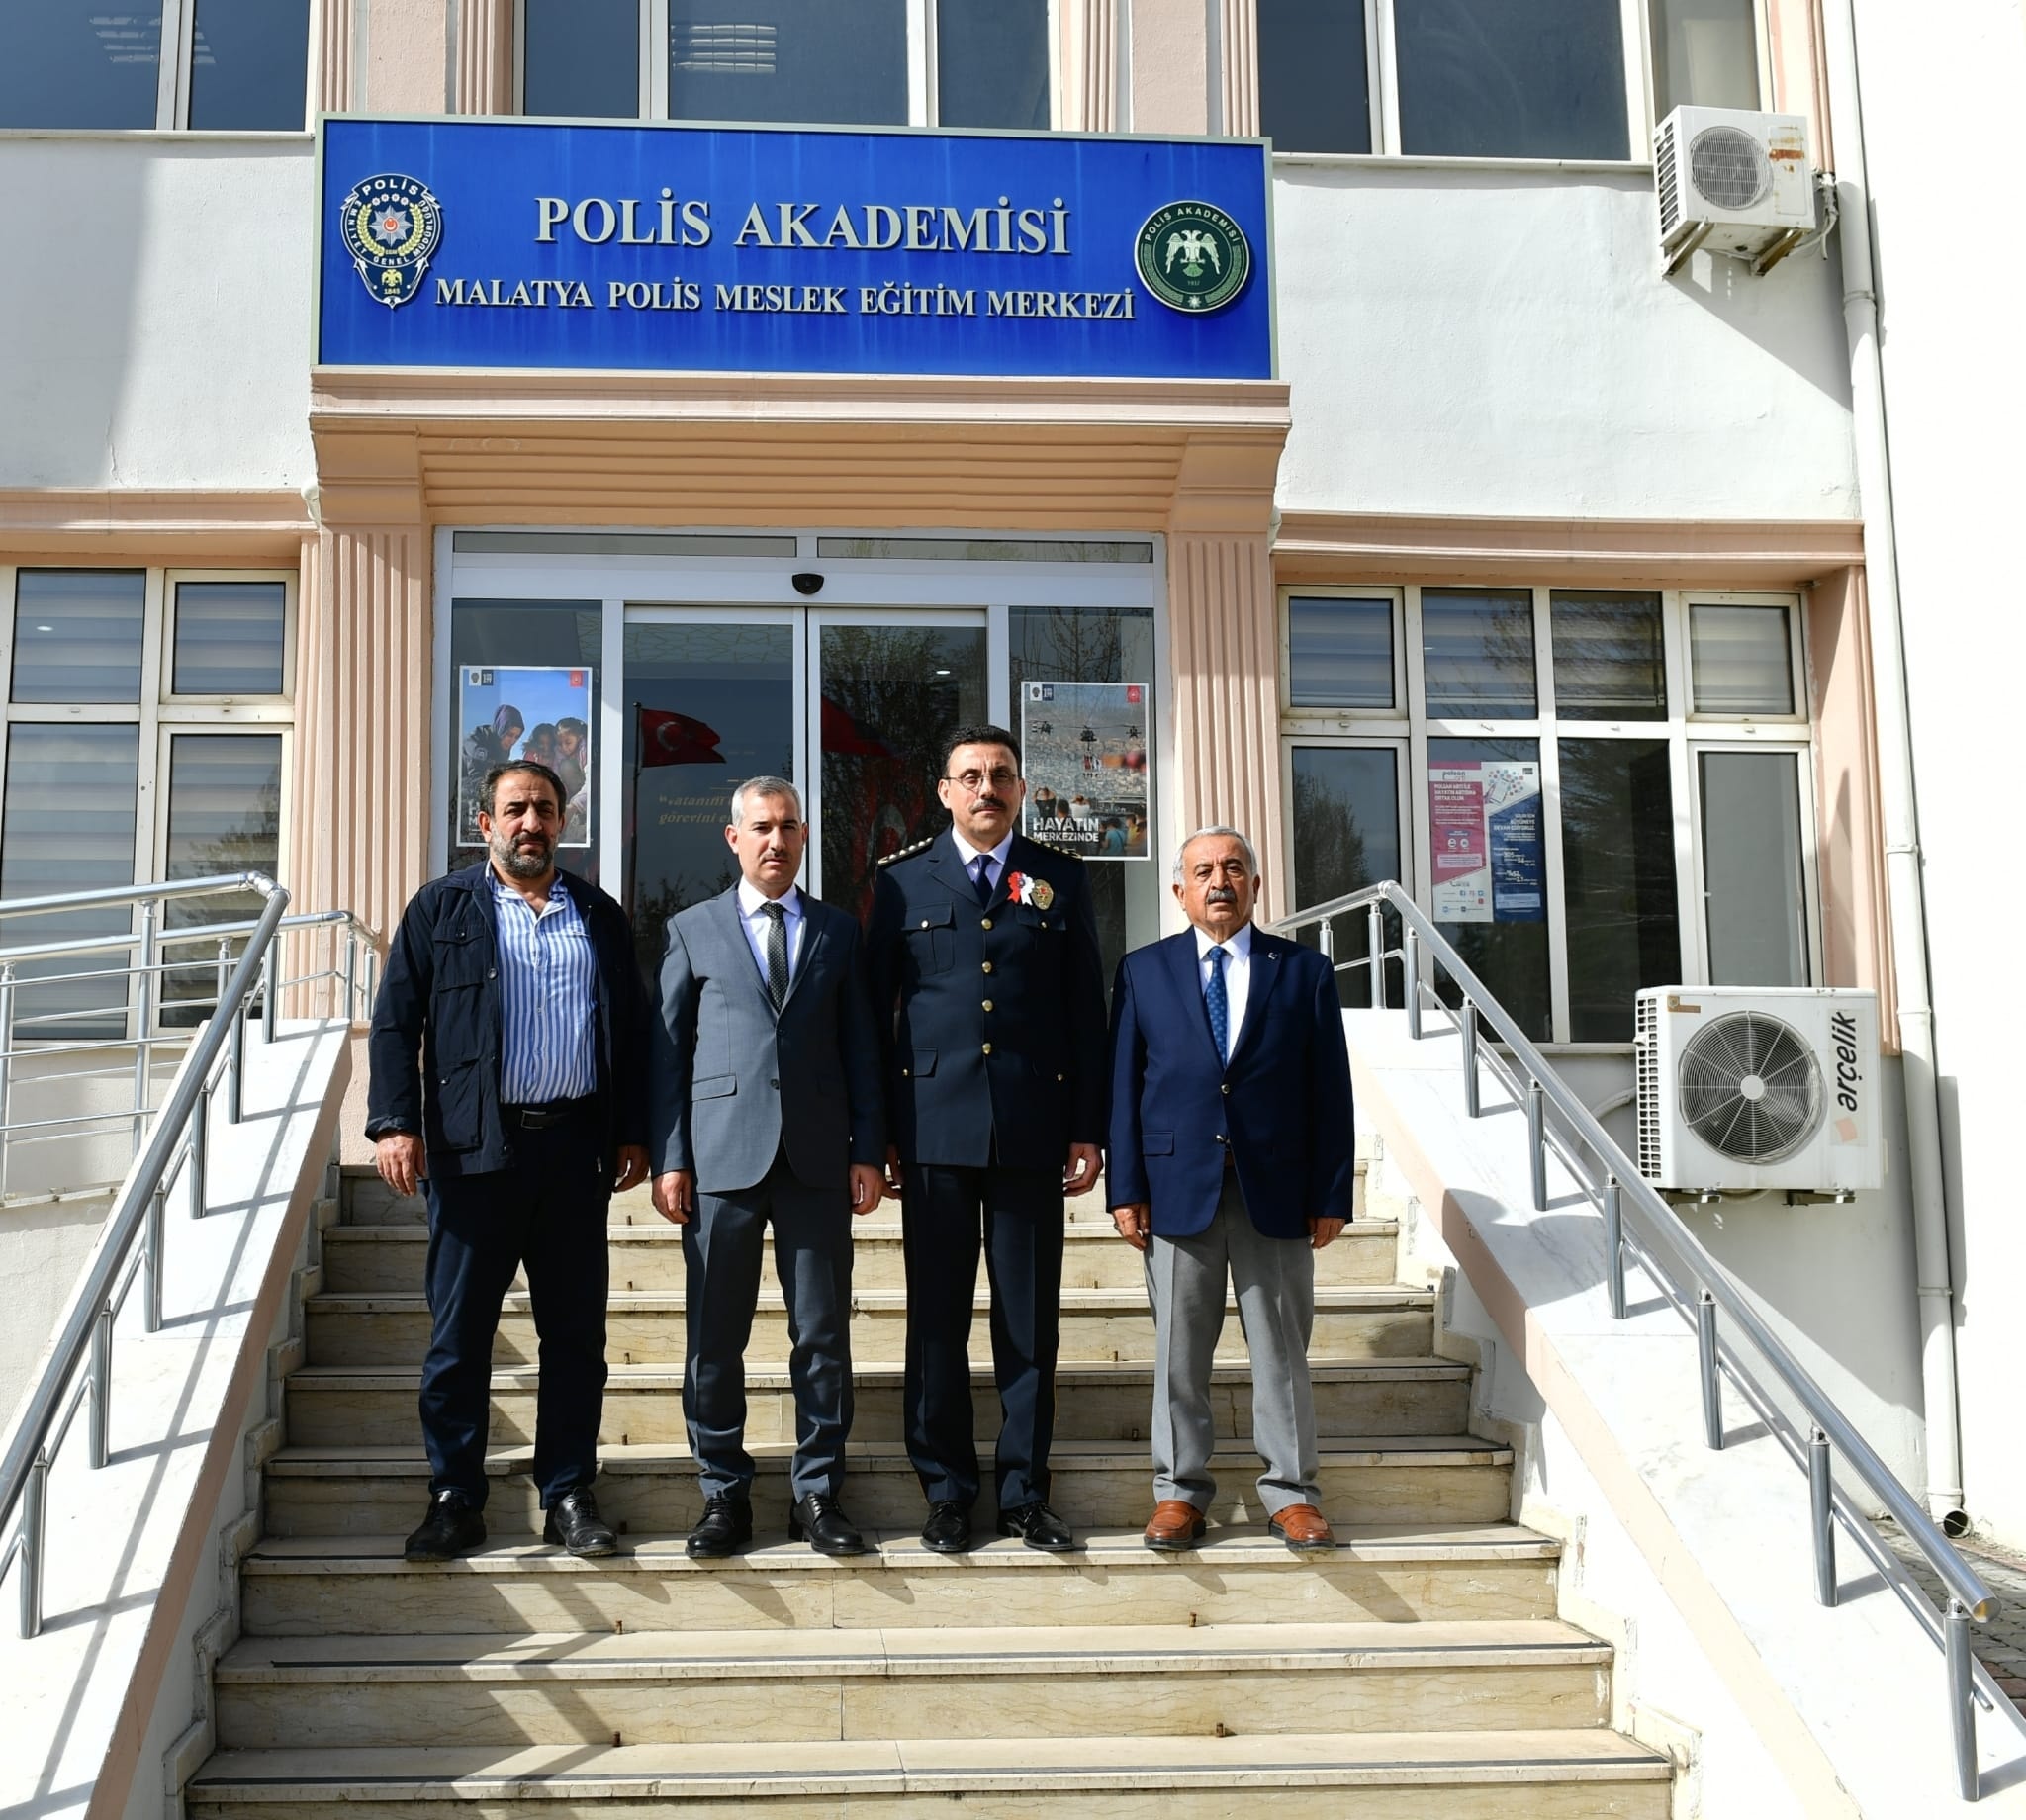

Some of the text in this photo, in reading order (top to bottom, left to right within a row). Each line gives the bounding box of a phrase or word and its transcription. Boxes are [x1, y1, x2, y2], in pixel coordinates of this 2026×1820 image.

[361, 178, 418, 196] POLİS
[535, 187, 1070, 254] POLİS AKADEMİSİ
[1144, 207, 1240, 242] POLİS AKADEMİSİ
[373, 255, 410, 266] GENEL
[435, 276, 1137, 318] MALATYA POLİS MESLEK EĞİTİM MERKEZİ
[1033, 817, 1099, 832] HAYATIN
[1033, 832, 1099, 842] MERKEZİNDE
[1831, 1011, 1863, 1112] arçelik
